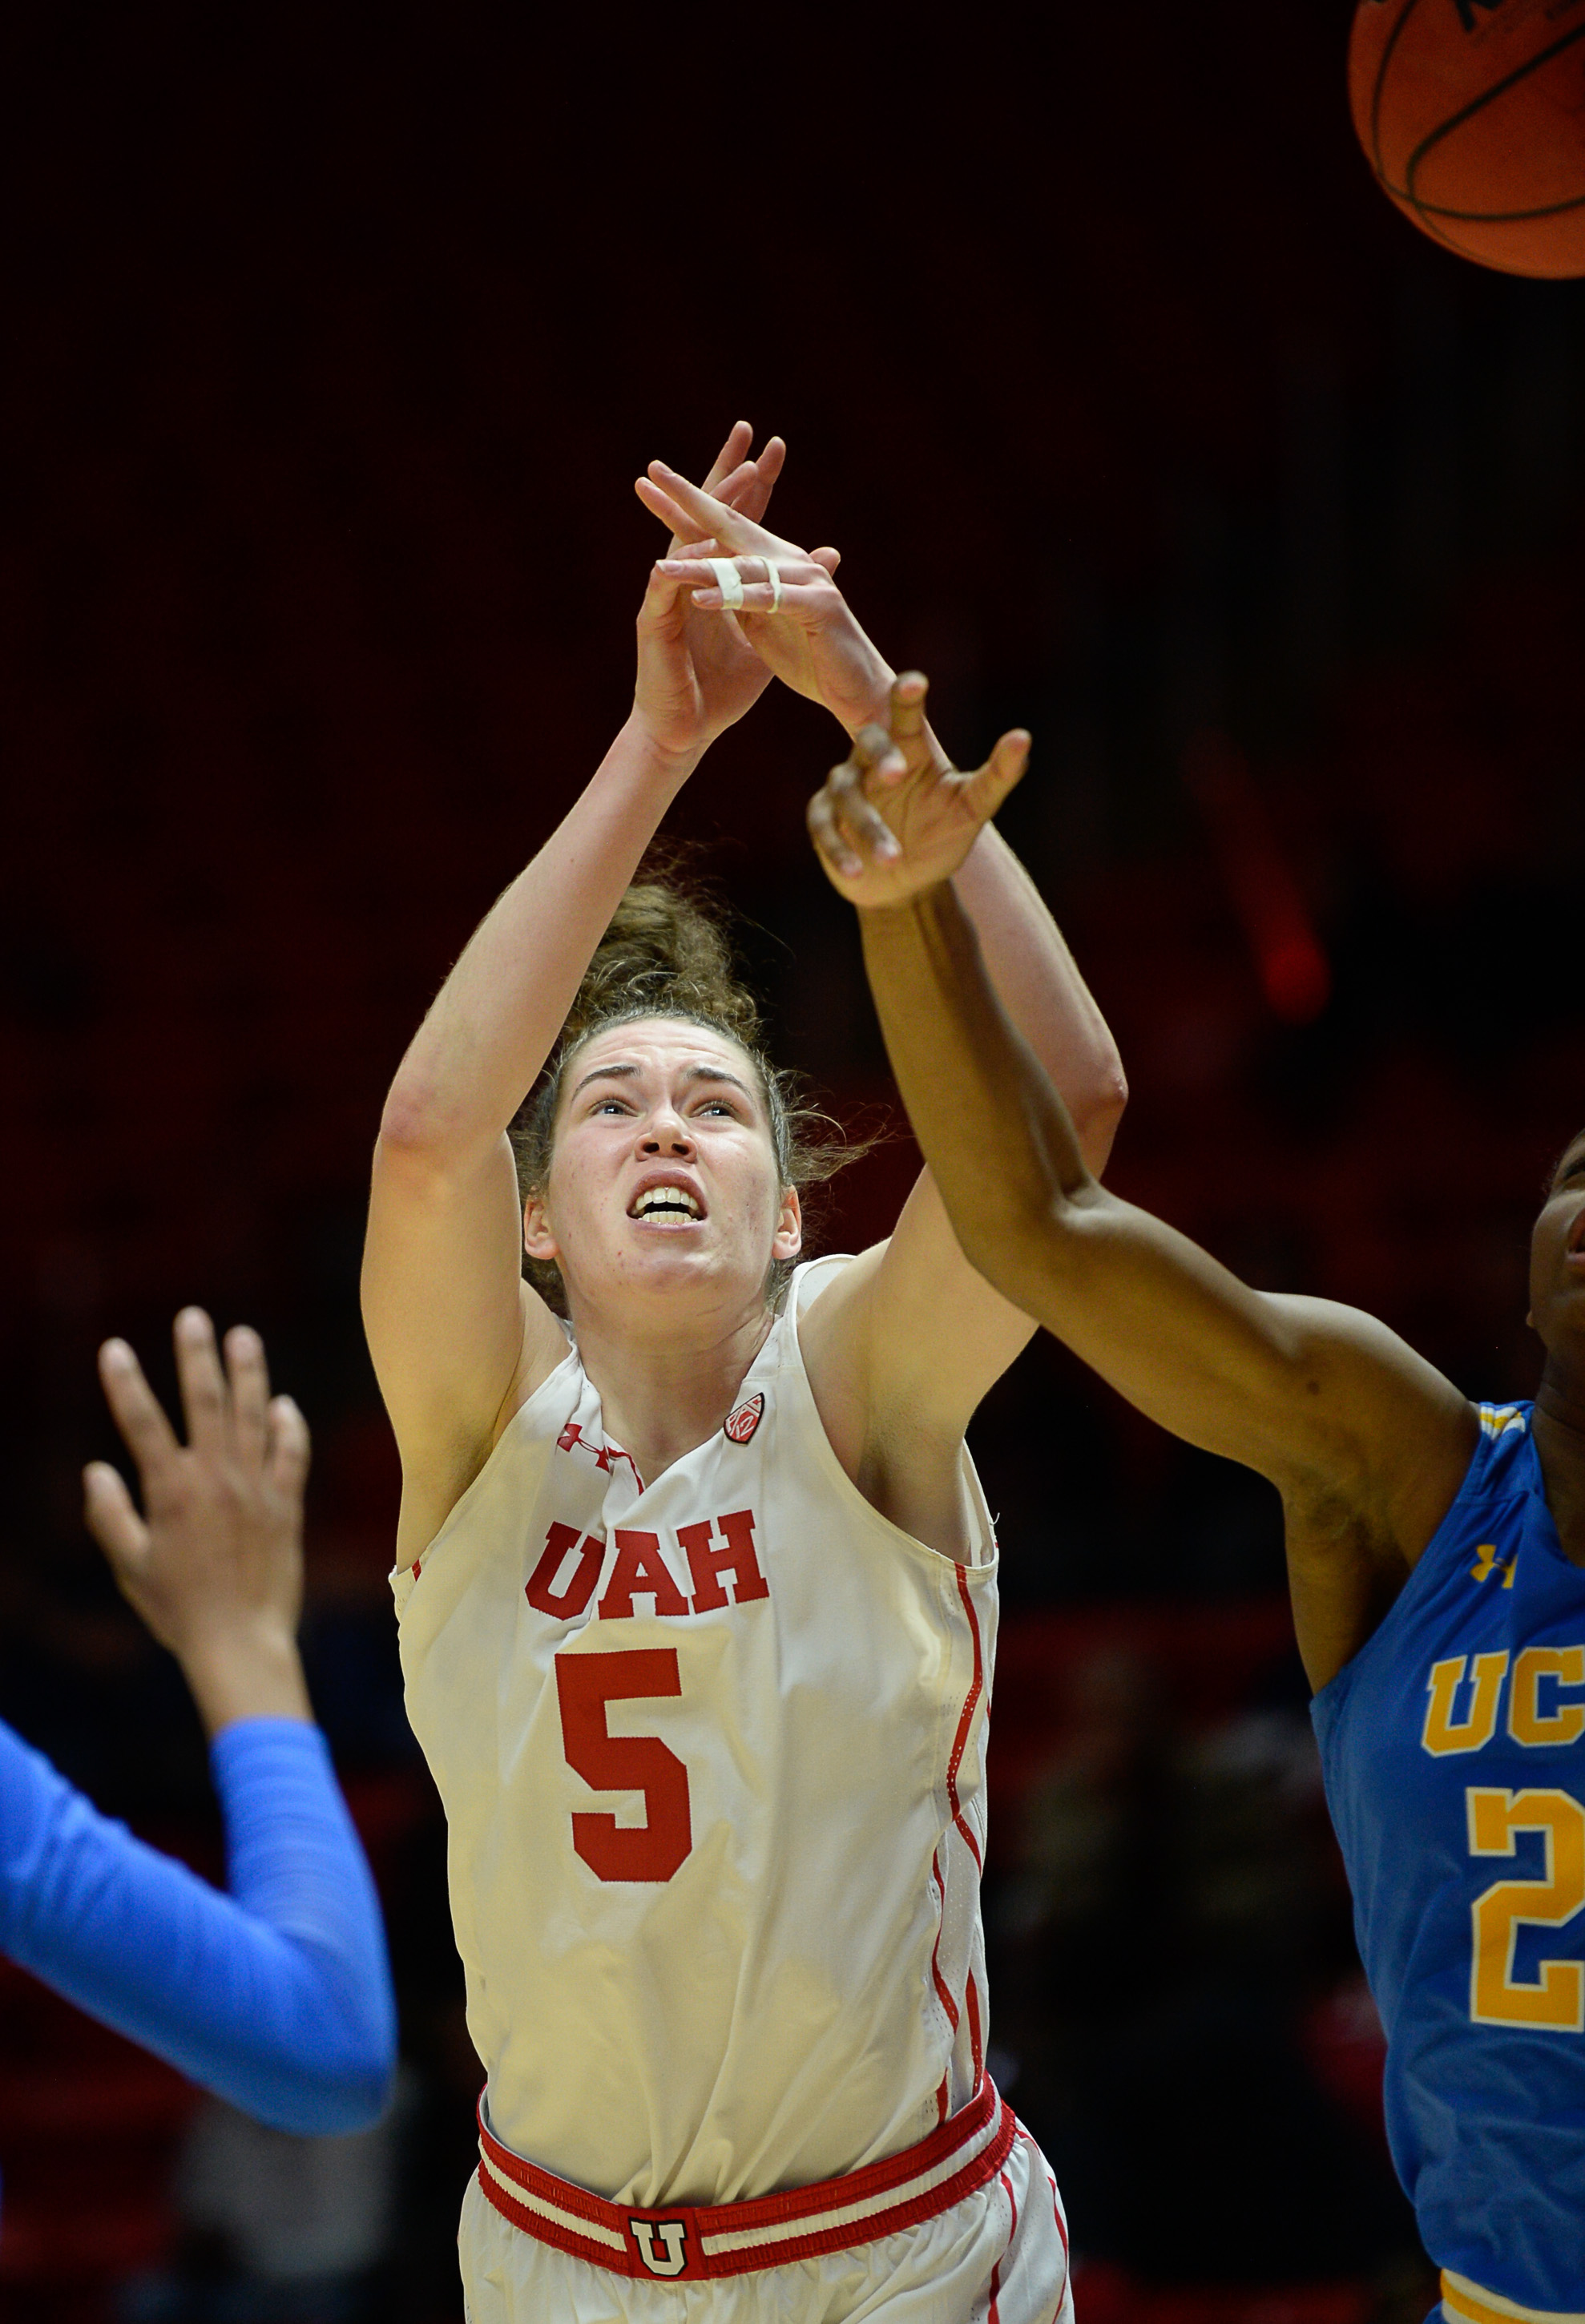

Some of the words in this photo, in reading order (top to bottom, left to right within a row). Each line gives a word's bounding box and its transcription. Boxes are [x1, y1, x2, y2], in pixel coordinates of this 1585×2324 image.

[525, 1509, 770, 1620] UAH
[555, 1648, 692, 1882] 5
[1466, 1787, 1585, 2032] 2
[628, 2217, 688, 2277] U
